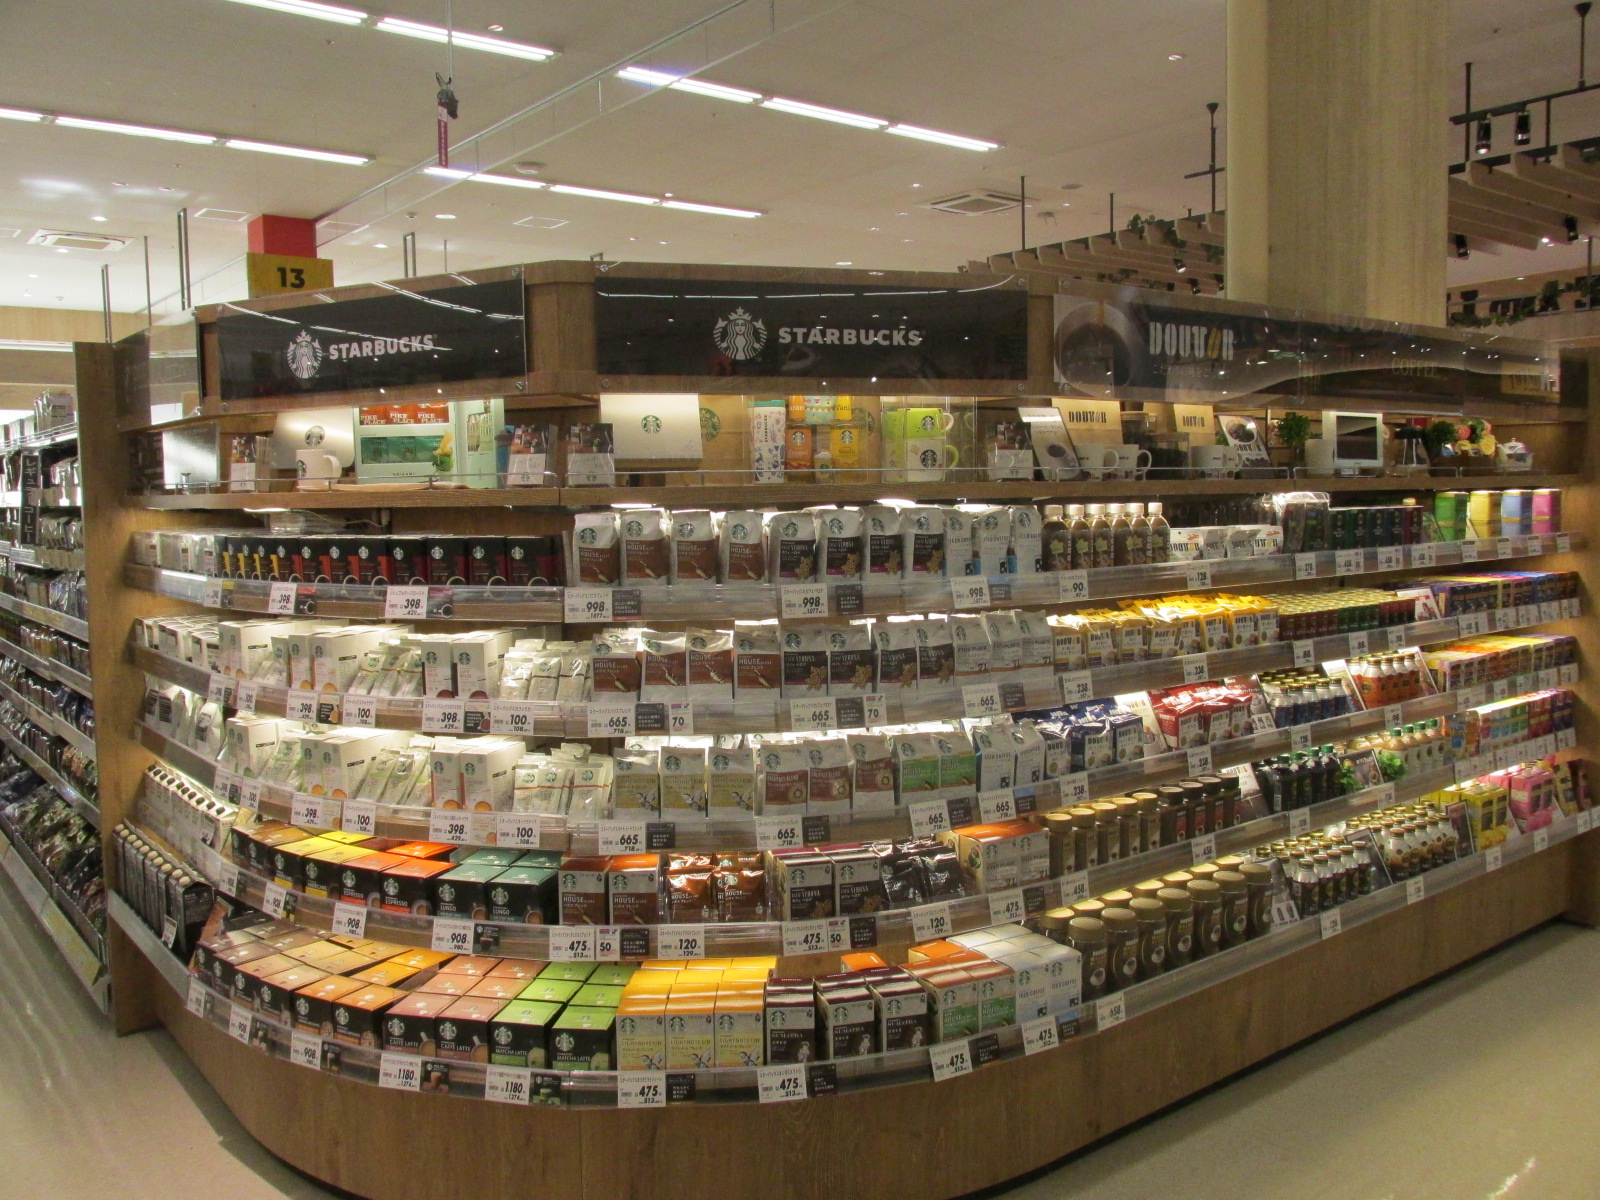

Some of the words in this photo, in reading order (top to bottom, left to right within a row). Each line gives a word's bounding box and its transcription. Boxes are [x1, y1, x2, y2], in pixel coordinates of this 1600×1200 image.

[277, 267, 305, 288] 13
[778, 326, 921, 347] STARBUCKS
[1149, 321, 1234, 361] DOUTOR
[329, 334, 433, 360] STARBUCKS
[1068, 411, 1107, 424] DOUTOR
[1254, 538, 1278, 548] UTOR
[970, 587, 984, 598] 998
[1073, 582, 1084, 592] 90
[280, 594, 291, 604] 398
[404, 599, 421, 609] 398
[802, 597, 820, 608] 998
[586, 602, 605, 612] 998
[1042, 656, 1052, 664] 71
[978, 662, 987, 672] 71
[1077, 683, 1088, 694] 238
[980, 696, 994, 706] 665
[300, 703, 312, 713] 398
[358, 708, 370, 718] 100
[868, 709, 879, 718] 70
[441, 712, 458, 722] 398
[510, 714, 527, 725] 100
[608, 716, 628, 728] 665
[672, 717, 685, 726] 70
[812, 711, 830, 722] 665
[1198, 758, 1208, 767] 238
[1073, 786, 1084, 794] 238
[996, 801, 1010, 812] 665
[305, 808, 317, 818] 398
[357, 814, 370, 826] 100
[928, 814, 944, 825] 665
[448, 824, 464, 834] 398
[516, 827, 534, 838] 100
[777, 828, 796, 840] 665
[620, 834, 639, 845] 665
[344, 890, 364, 898] ESPRESSO
[1074, 884, 1085, 894] 458
[272, 898, 281, 908] 908
[386, 898, 408, 907] ESPRESSO
[1006, 902, 1019, 912] 475
[493, 908, 510, 916] LUNGO
[347, 918, 360, 928] 908
[930, 916, 944, 929] 120
[450, 933, 468, 944] 908
[803, 933, 820, 945] 475
[830, 934, 841, 942] 50
[568, 941, 587, 952] 475
[600, 942, 611, 952] 50
[679, 939, 697, 950] 120
[238, 1022, 248, 1034] 908
[1038, 1028, 1052, 1041] 475
[304, 1047, 316, 1060] 908
[496, 1048, 514, 1056] MATCHA
[950, 1054, 965, 1066] 475
[780, 1078, 798, 1090] 475
[639, 1086, 658, 1097] 475
